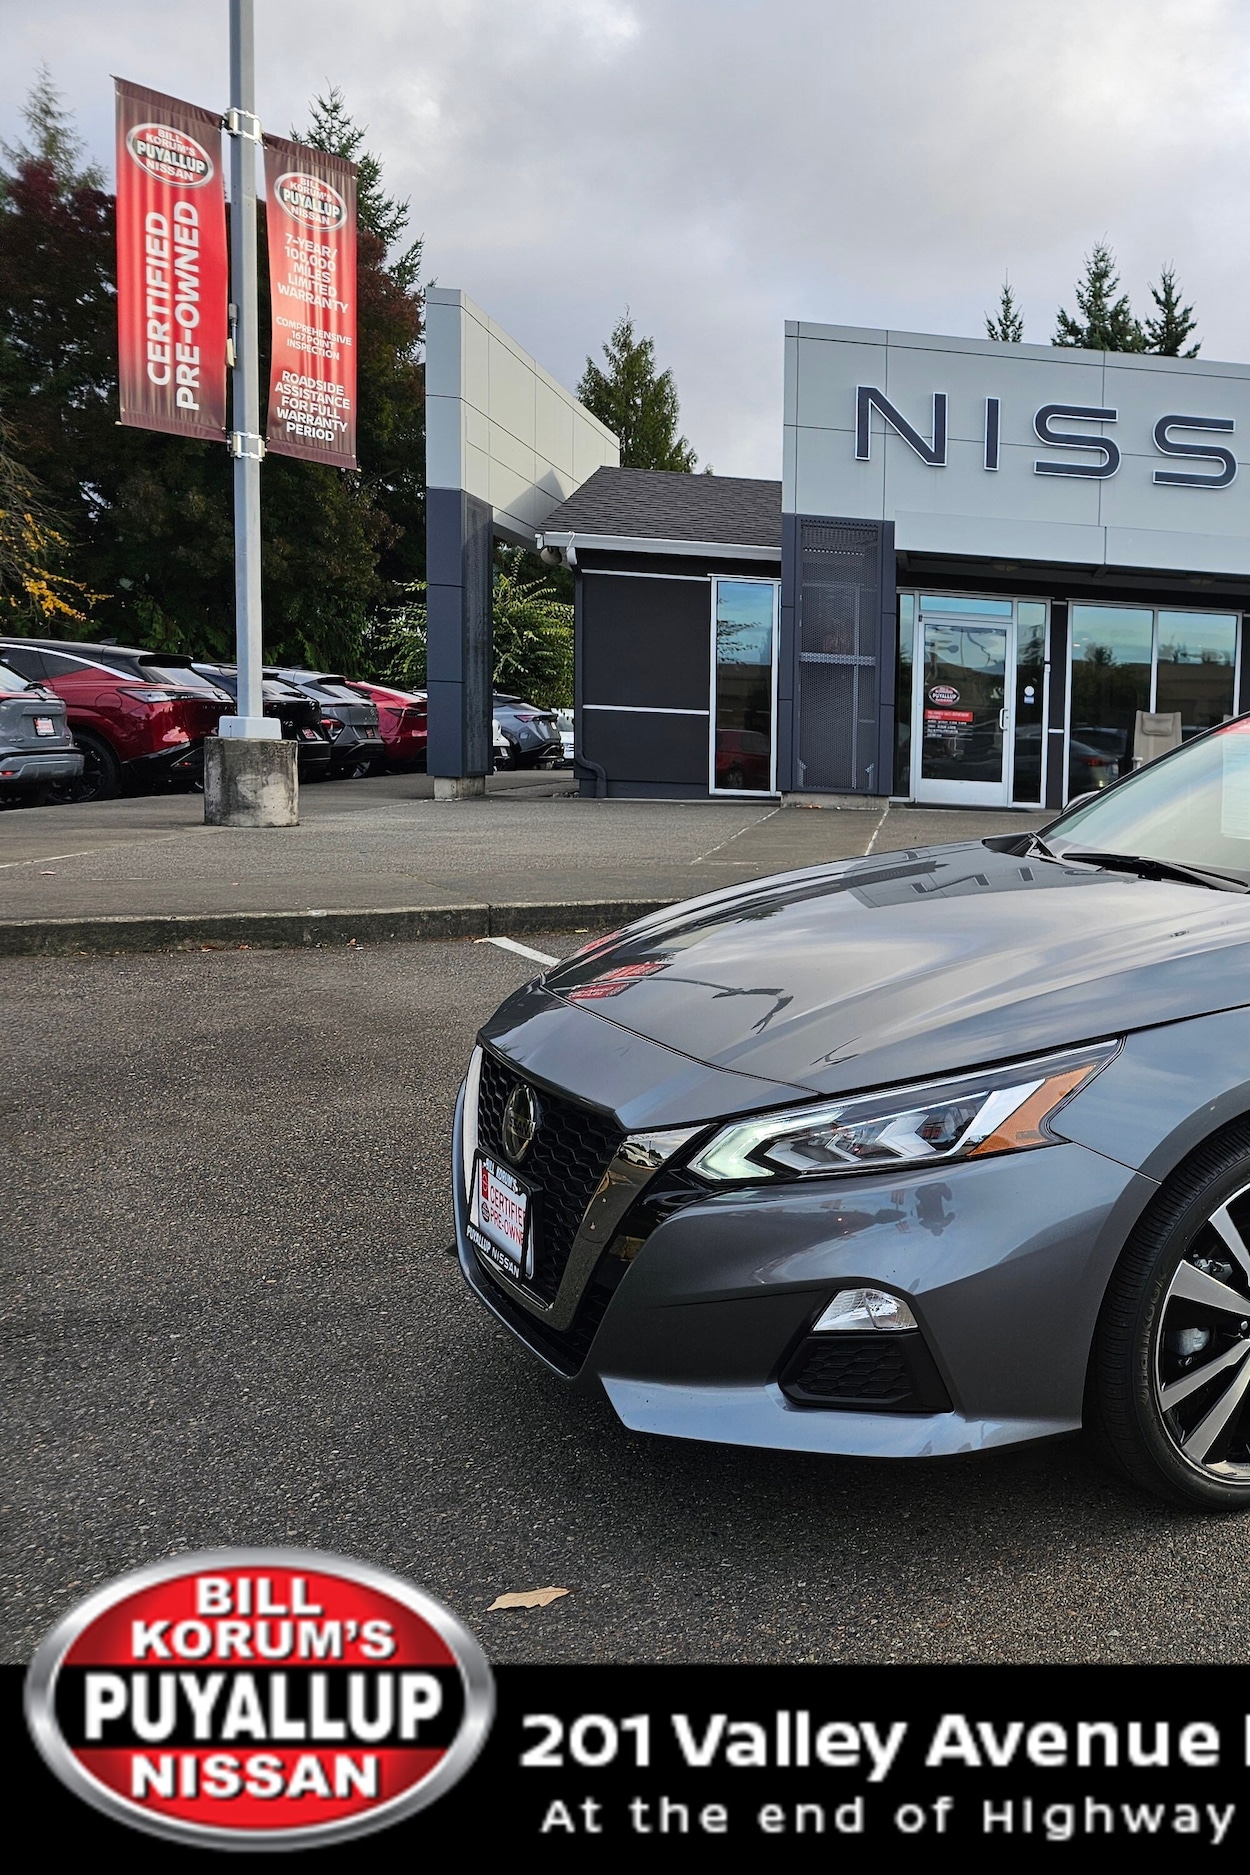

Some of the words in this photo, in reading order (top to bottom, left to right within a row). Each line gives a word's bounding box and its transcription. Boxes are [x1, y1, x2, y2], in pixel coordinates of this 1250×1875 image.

[145, 132, 197, 157] KORUM'S
[157, 128, 183, 144] BILL
[136, 139, 206, 174] PUYALLUP
[145, 159, 194, 182] NISSAN
[300, 177, 320, 191] BILL
[283, 187, 340, 219] PUYALLUP
[290, 181, 333, 203] KORUM'S
[290, 205, 331, 226] NISSAN
[284, 246, 337, 272] 100,000
[285, 232, 338, 260] 7-YEAR/
[287, 272, 338, 299] LIMITED
[293, 261, 332, 284] MILES
[146, 210, 170, 386] CERTIFIED
[175, 201, 200, 410] PRE-OWNED
[277, 282, 349, 314] WARRANTY
[276, 316, 353, 346] COMPREHENSIVE
[291, 330, 307, 342] 167
[306, 333, 336, 350] POINT
[286, 338, 340, 361] INSPECTION
[275, 381, 351, 410] ASSISTANCE
[282, 370, 345, 397] ROADSIDE
[276, 406, 348, 433] WARRANTY
[281, 395, 308, 413] FOR
[309, 401, 341, 420] FULL
[286, 421, 335, 442] PERIOD
[490, 1185, 526, 1228] CERTIFIE
[466, 1225, 492, 1254] PUYALLUP
[492, 1246, 520, 1278] NISSAN
